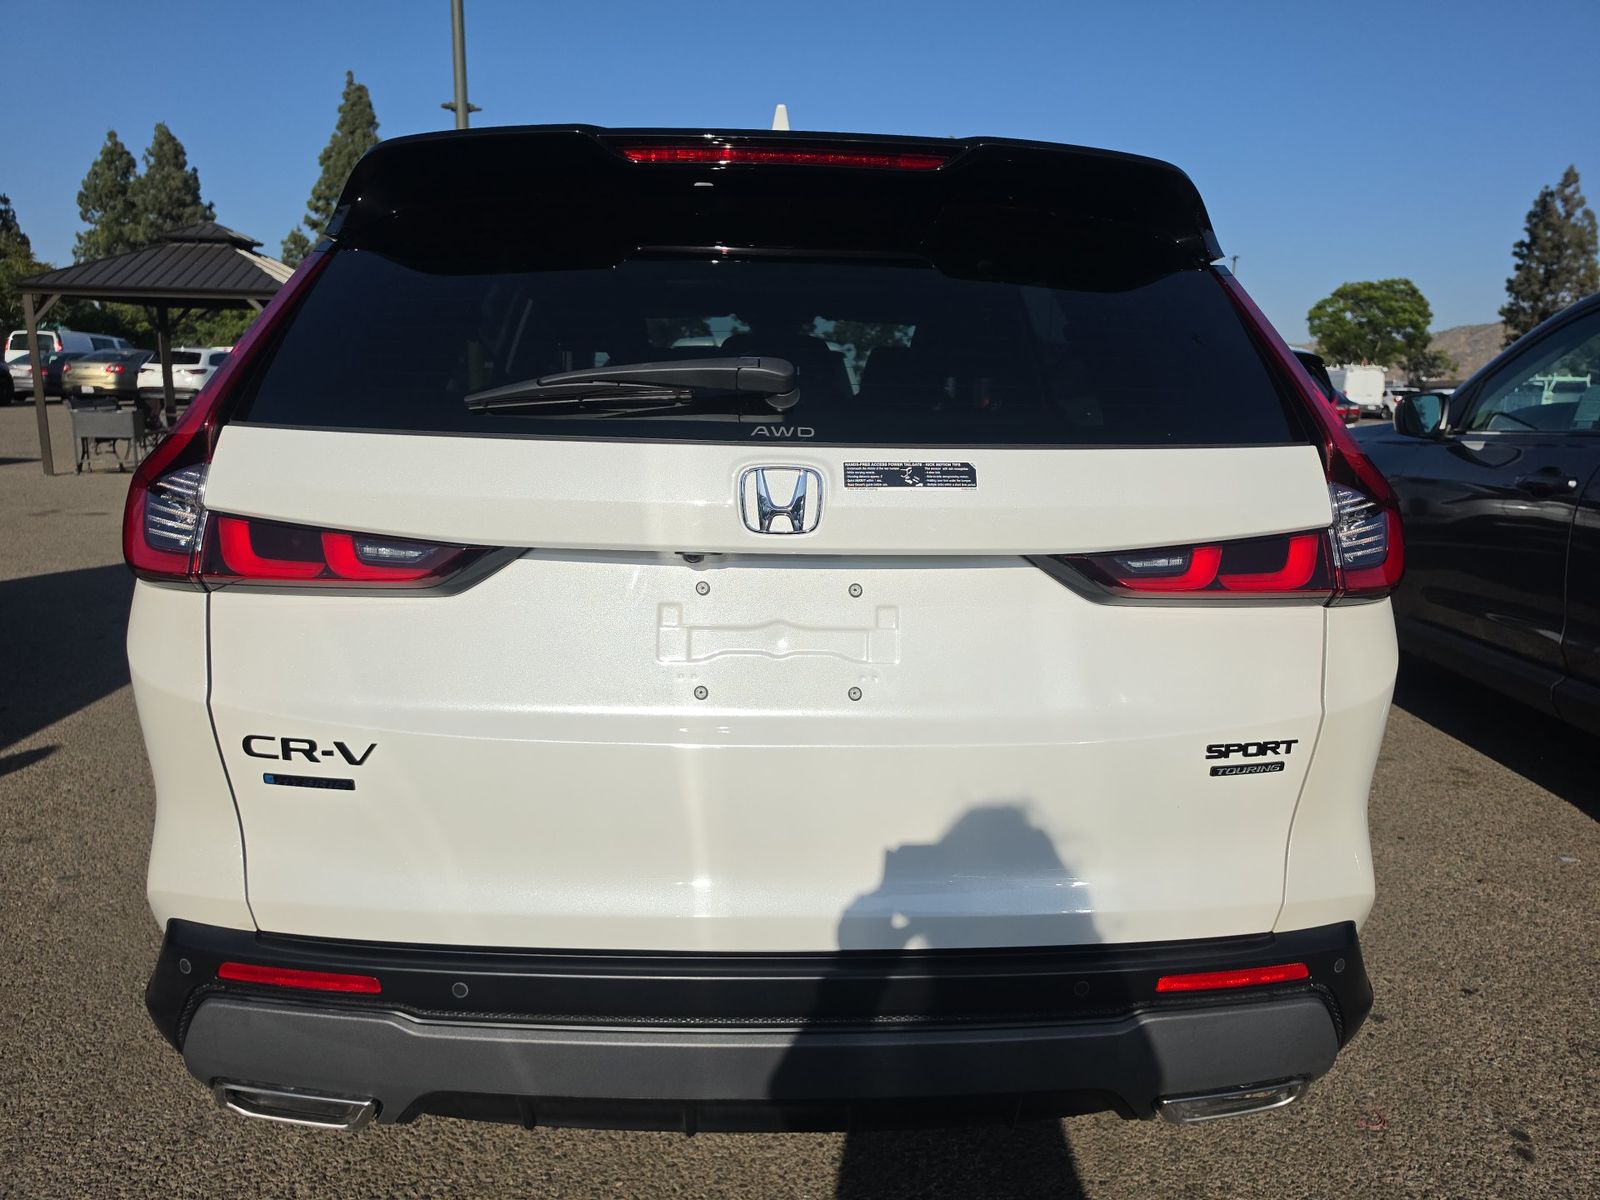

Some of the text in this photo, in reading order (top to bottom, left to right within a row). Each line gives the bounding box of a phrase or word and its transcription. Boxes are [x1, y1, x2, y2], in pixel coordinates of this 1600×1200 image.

[751, 426, 815, 437] AWD
[242, 735, 377, 765] CR-V
[1205, 739, 1298, 759] SPORT
[1216, 764, 1281, 775] TOURING
